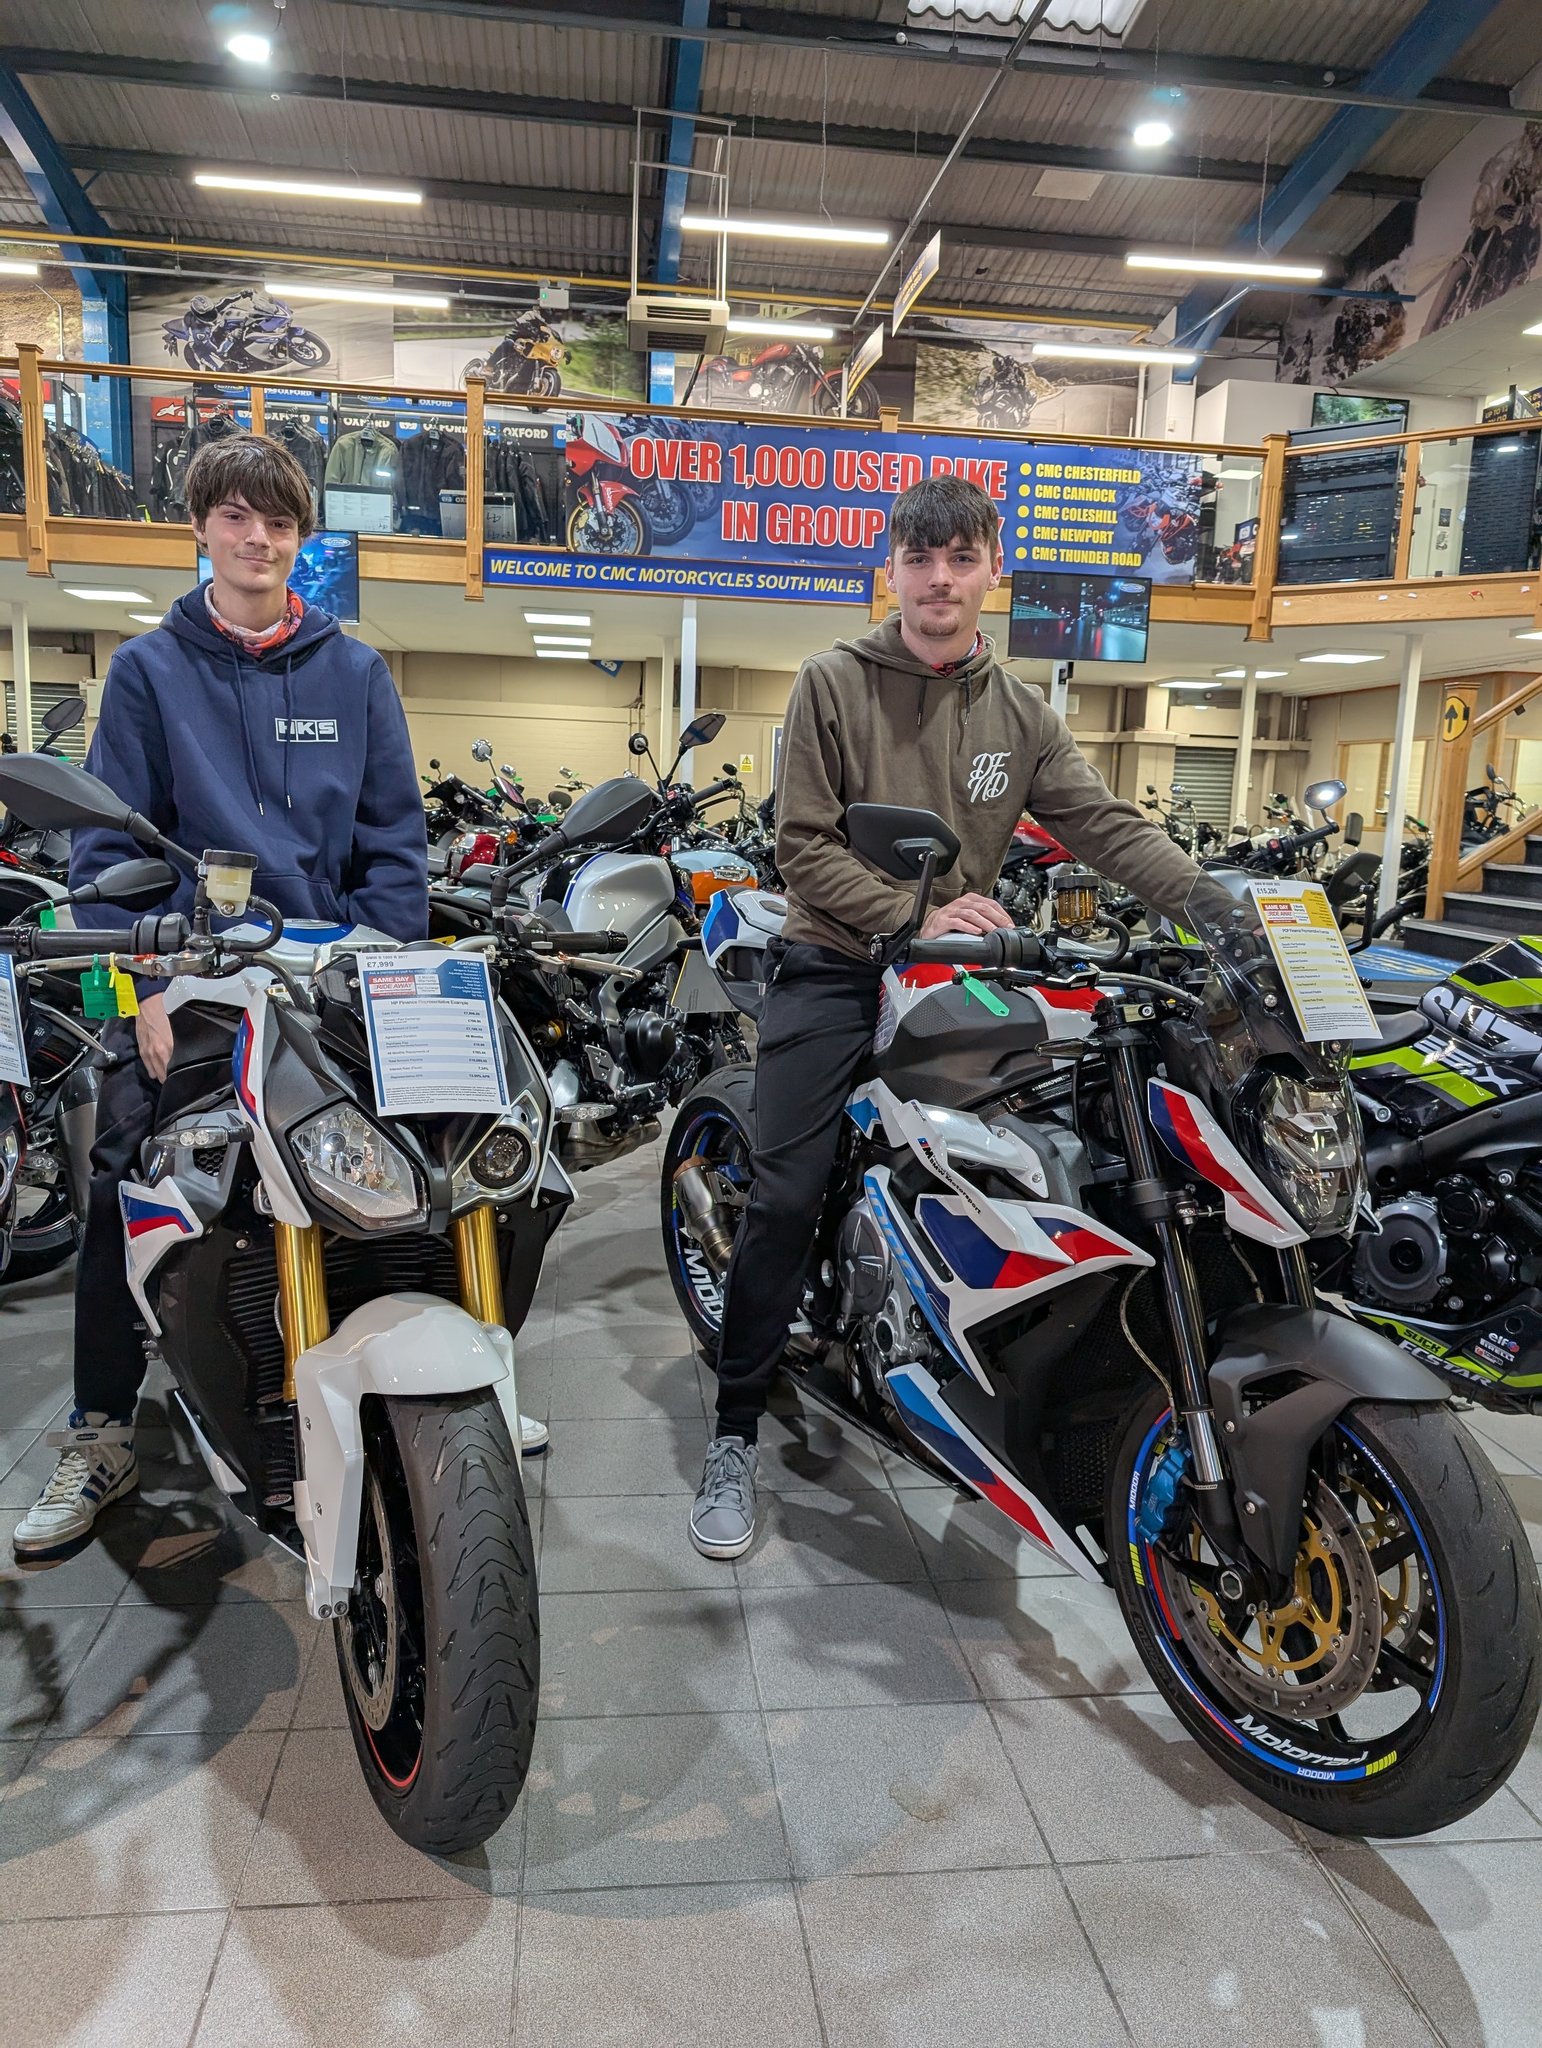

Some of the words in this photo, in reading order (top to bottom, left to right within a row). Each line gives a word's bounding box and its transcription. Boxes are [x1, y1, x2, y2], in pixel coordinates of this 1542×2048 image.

[419, 398, 453, 407] OXFORD
[503, 427, 548, 439] OXFORD
[629, 437, 722, 483] OVER
[729, 444, 826, 490] 1,000
[833, 450, 923, 493] USED
[1035, 463, 1063, 478] CMC
[1064, 465, 1141, 484] CHESTERFIELD
[1034, 484, 1061, 499] CMC
[1062, 485, 1117, 503] CANNOCK
[721, 500, 758, 542] IN
[766, 503, 885, 549] GROUP
[1033, 505, 1060, 519] CMC
[1061, 506, 1118, 524] COLESHILL
[1032, 526, 1058, 541] CMC
[1060, 527, 1114, 545] NEWPORT
[1031, 546, 1057, 561] CMC
[1059, 548, 1109, 565] THUNDER
[1111, 551, 1142, 567] ROAD
[490, 559, 572, 578] WELCOME
[575, 564, 597, 579] TO
[600, 566, 636, 581] CMC
[638, 568, 754, 588] MOTORCYCLES
[756, 575, 811, 591] SOUTH
[813, 578, 865, 594] WALES
[279, 721, 335, 735] HKS
[945, 1174, 981, 1215] Motorsport
[1488, 1332, 1510, 1346] elf
[1398, 1339, 1492, 1387] ECSTAR
[1129, 1470, 1141, 1511] M1000R
[1234, 1714, 1369, 1766] Motorrad
[1297, 1767, 1336, 1781] M1000R
